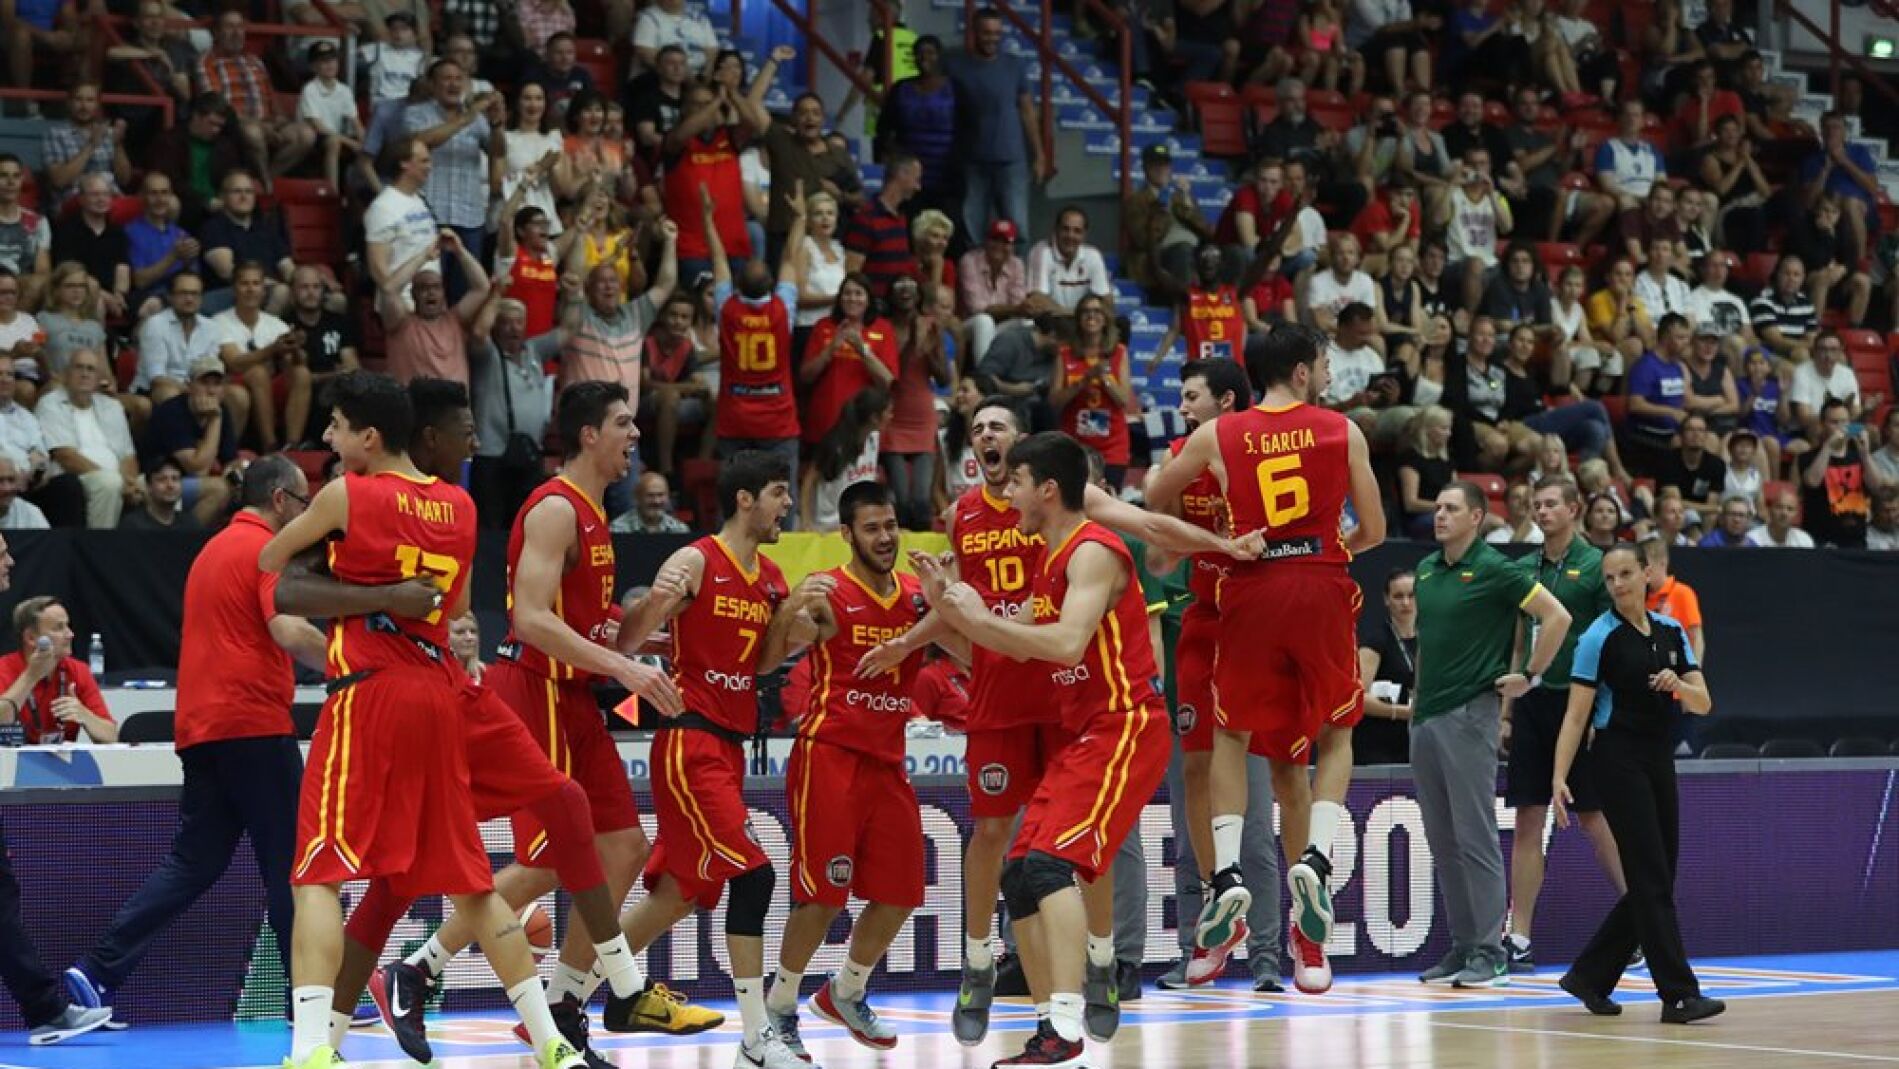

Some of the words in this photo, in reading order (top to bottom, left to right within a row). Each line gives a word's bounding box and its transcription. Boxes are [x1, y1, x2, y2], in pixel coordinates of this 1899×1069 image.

[734, 332, 777, 371] 10
[1243, 431, 1258, 455] S.
[1260, 428, 1315, 453] GARCIA
[396, 490, 414, 516] M.
[1256, 453, 1310, 528] 6
[985, 555, 1025, 594] 10
[738, 628, 757, 663] 7
